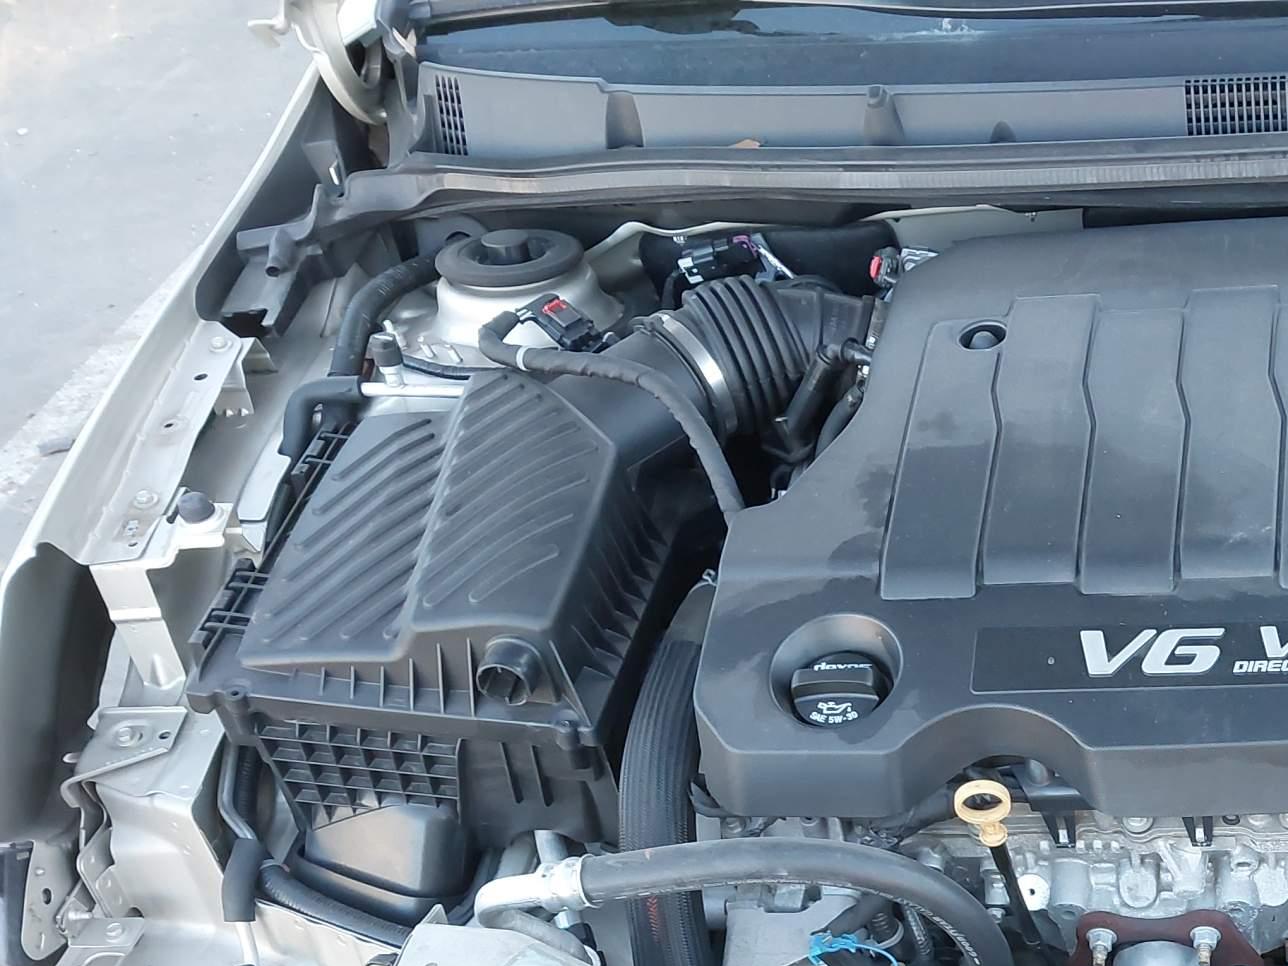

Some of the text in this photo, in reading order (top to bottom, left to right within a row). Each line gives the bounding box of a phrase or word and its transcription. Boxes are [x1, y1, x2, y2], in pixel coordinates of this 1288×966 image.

[1079, 627, 1226, 678] V6
[809, 711, 859, 724] SAE 5W-30
